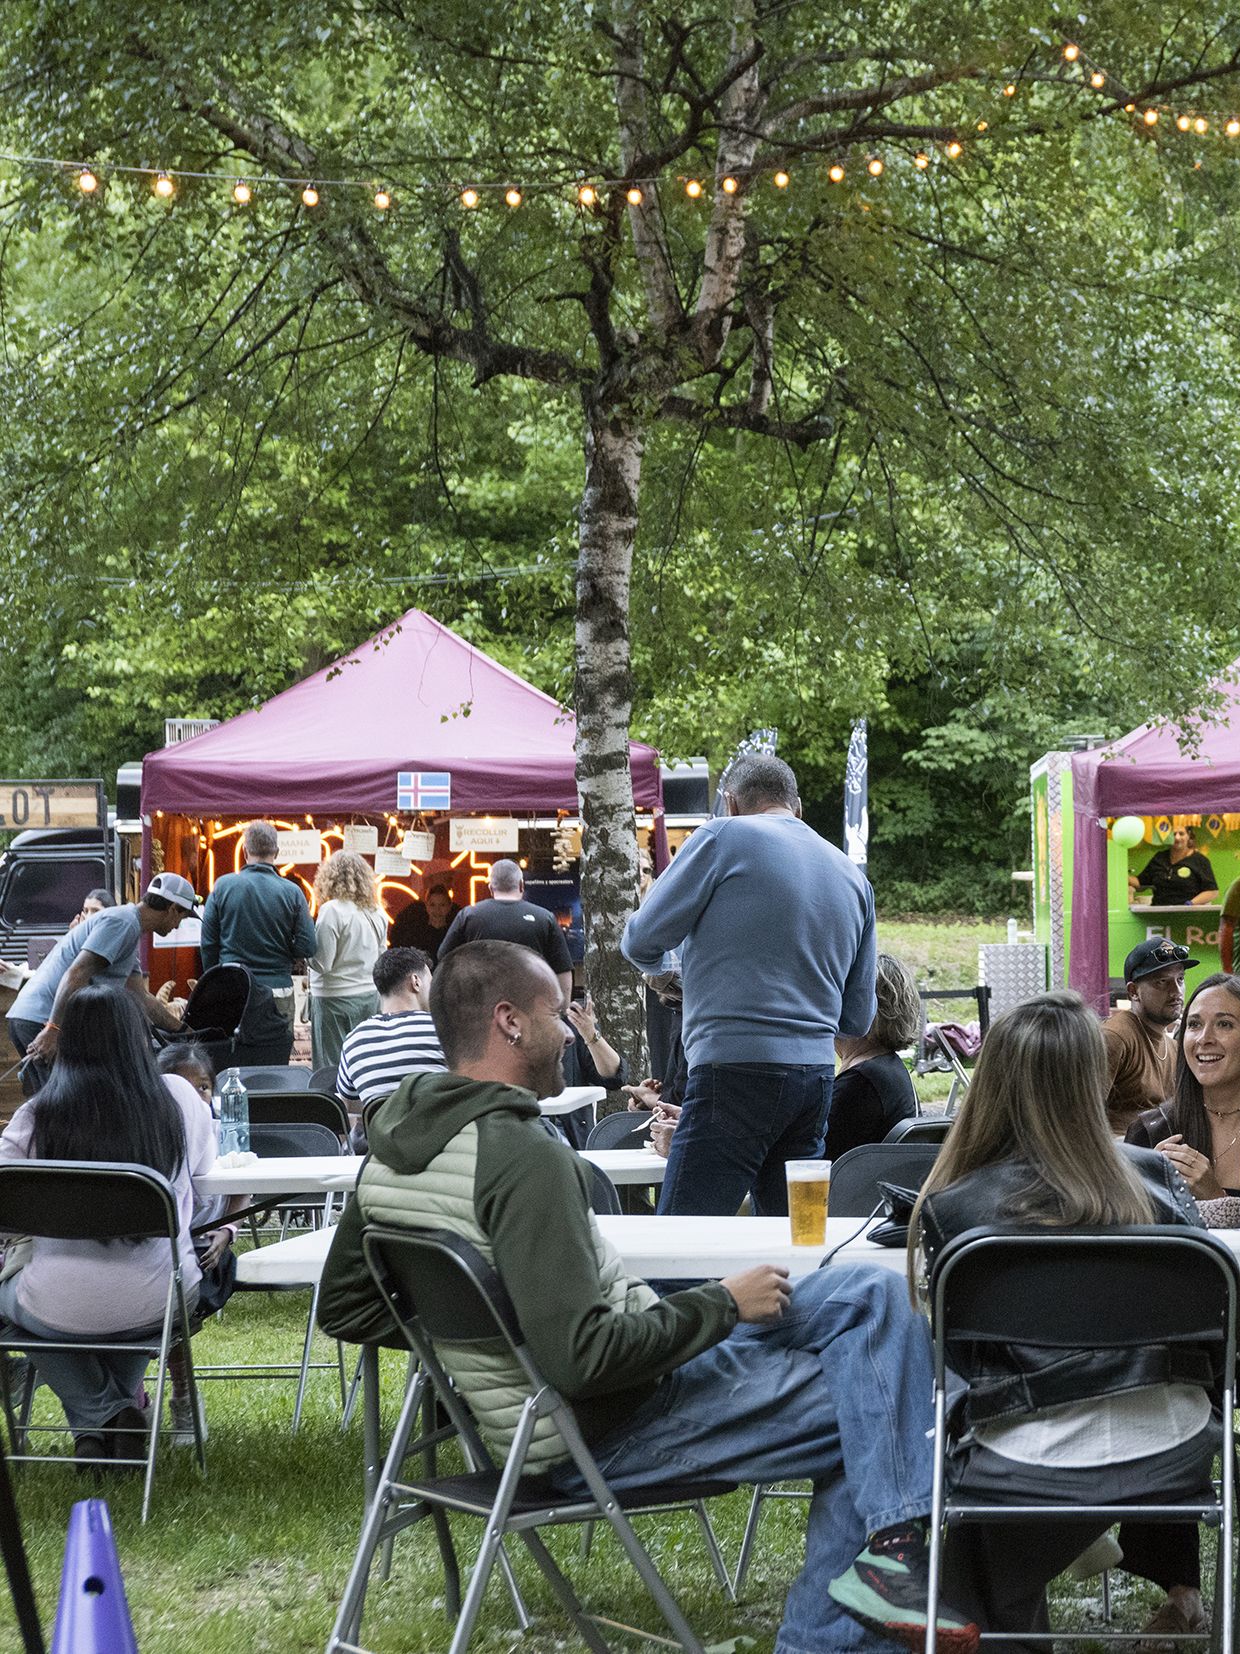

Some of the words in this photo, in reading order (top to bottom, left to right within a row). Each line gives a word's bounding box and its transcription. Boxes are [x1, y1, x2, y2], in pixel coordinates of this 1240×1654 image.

[0, 784, 56, 826] OT
[463, 828, 508, 837] RECOLLIR
[278, 839, 311, 848] MANA
[1186, 926, 1221, 945] Ra
